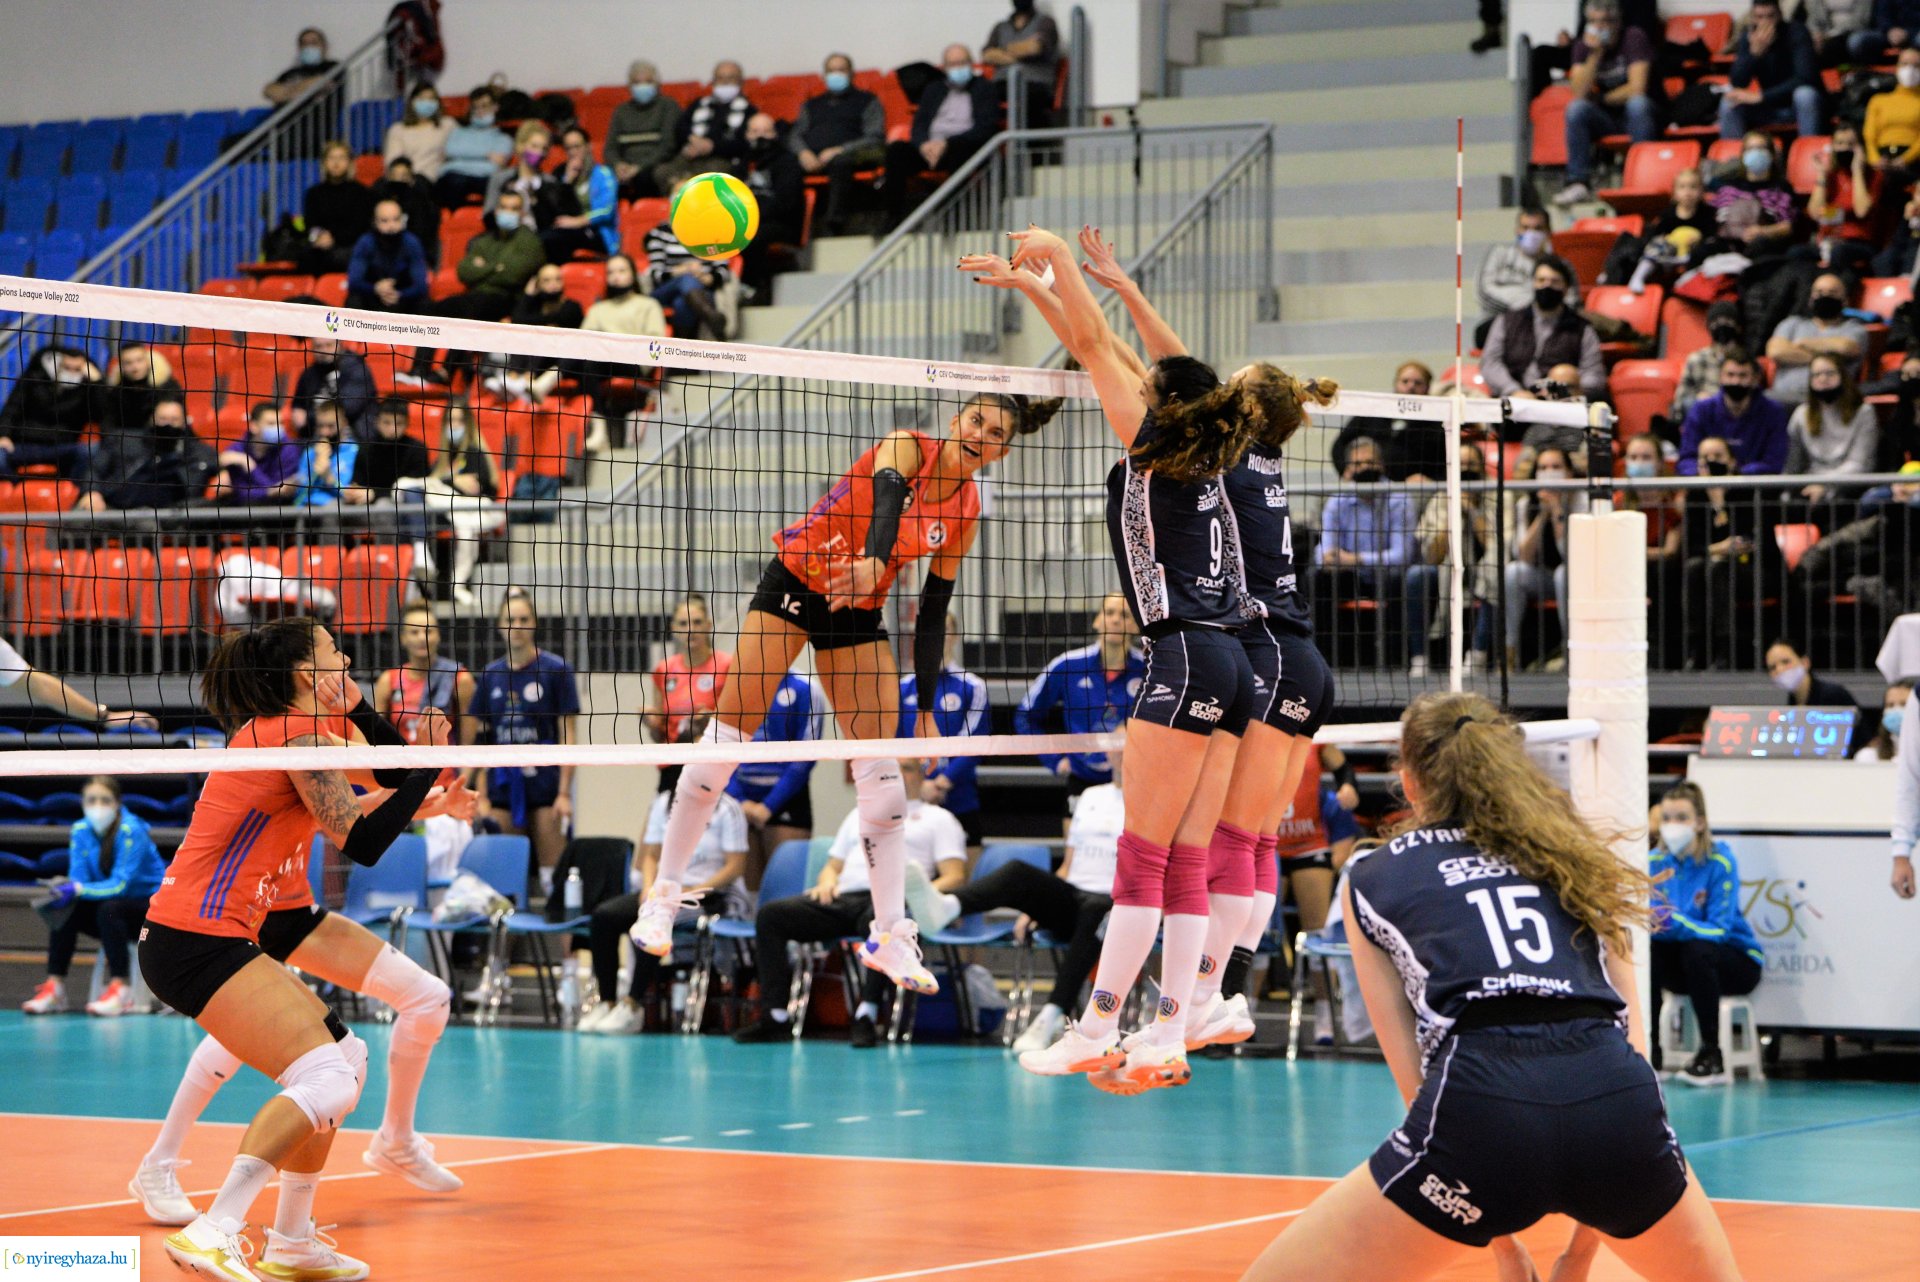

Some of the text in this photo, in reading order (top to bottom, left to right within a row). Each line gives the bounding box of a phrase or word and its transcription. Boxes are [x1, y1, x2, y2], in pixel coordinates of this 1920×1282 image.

[19, 289, 43, 300] League
[44, 291, 63, 303] Volley
[65, 293, 80, 302] 2022
[343, 319, 440, 336] CEV Champions League Volley 2022
[664, 347, 747, 362] CEV Champions League Volley 2022
[949, 371, 971, 382] Champions
[1210, 518, 1222, 577] 9
[1281, 516, 1294, 565] 4
[1465, 884, 1554, 970] 15
[1482, 972, 1574, 993] CHEMIK
